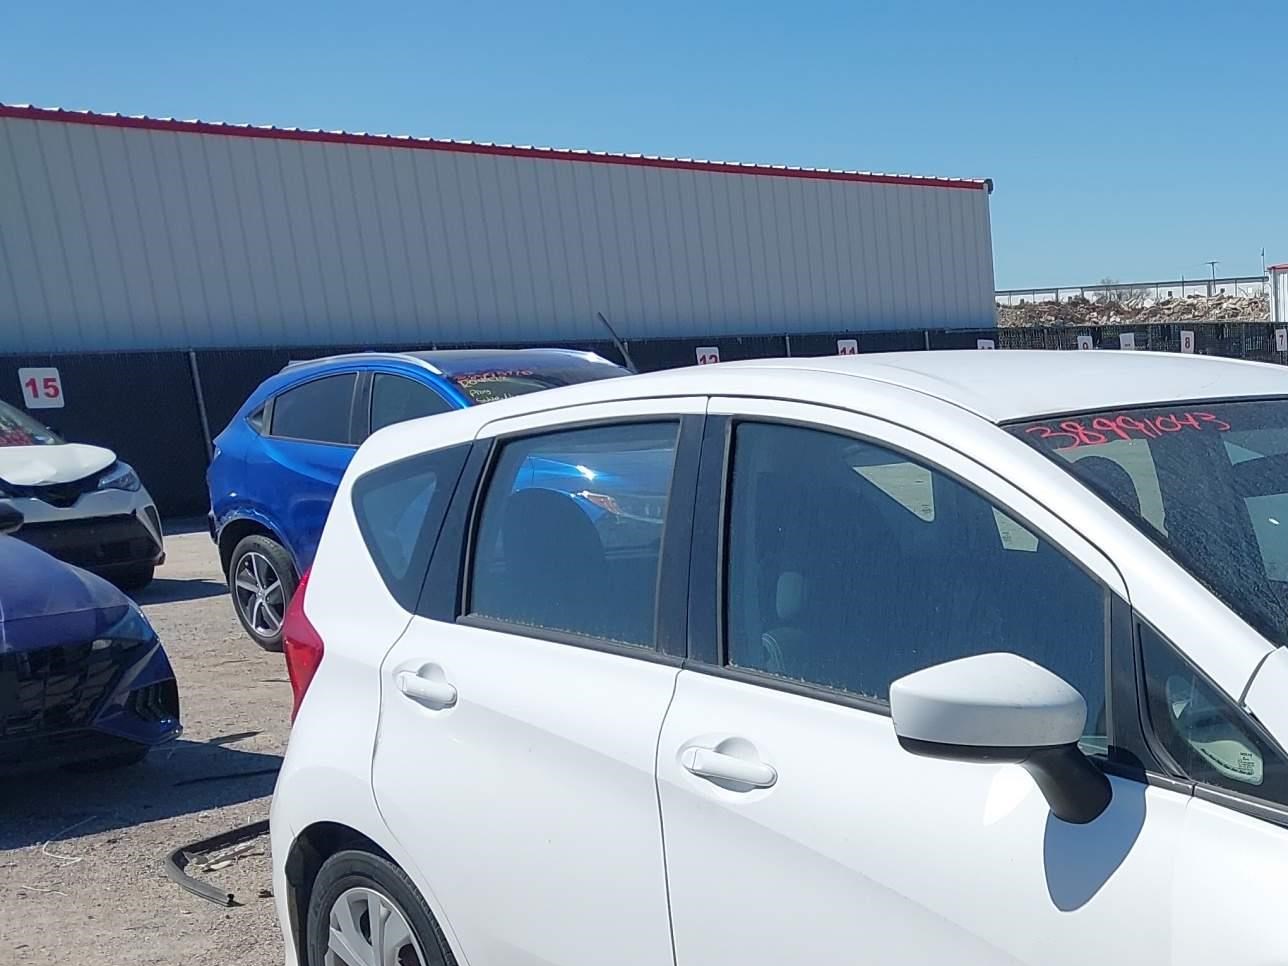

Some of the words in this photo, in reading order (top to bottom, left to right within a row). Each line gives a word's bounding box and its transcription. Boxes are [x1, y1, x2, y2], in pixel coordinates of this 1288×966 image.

[1184, 336, 1191, 349] 8
[25, 377, 60, 399] 15
[1025, 412, 1231, 450] 38991043
